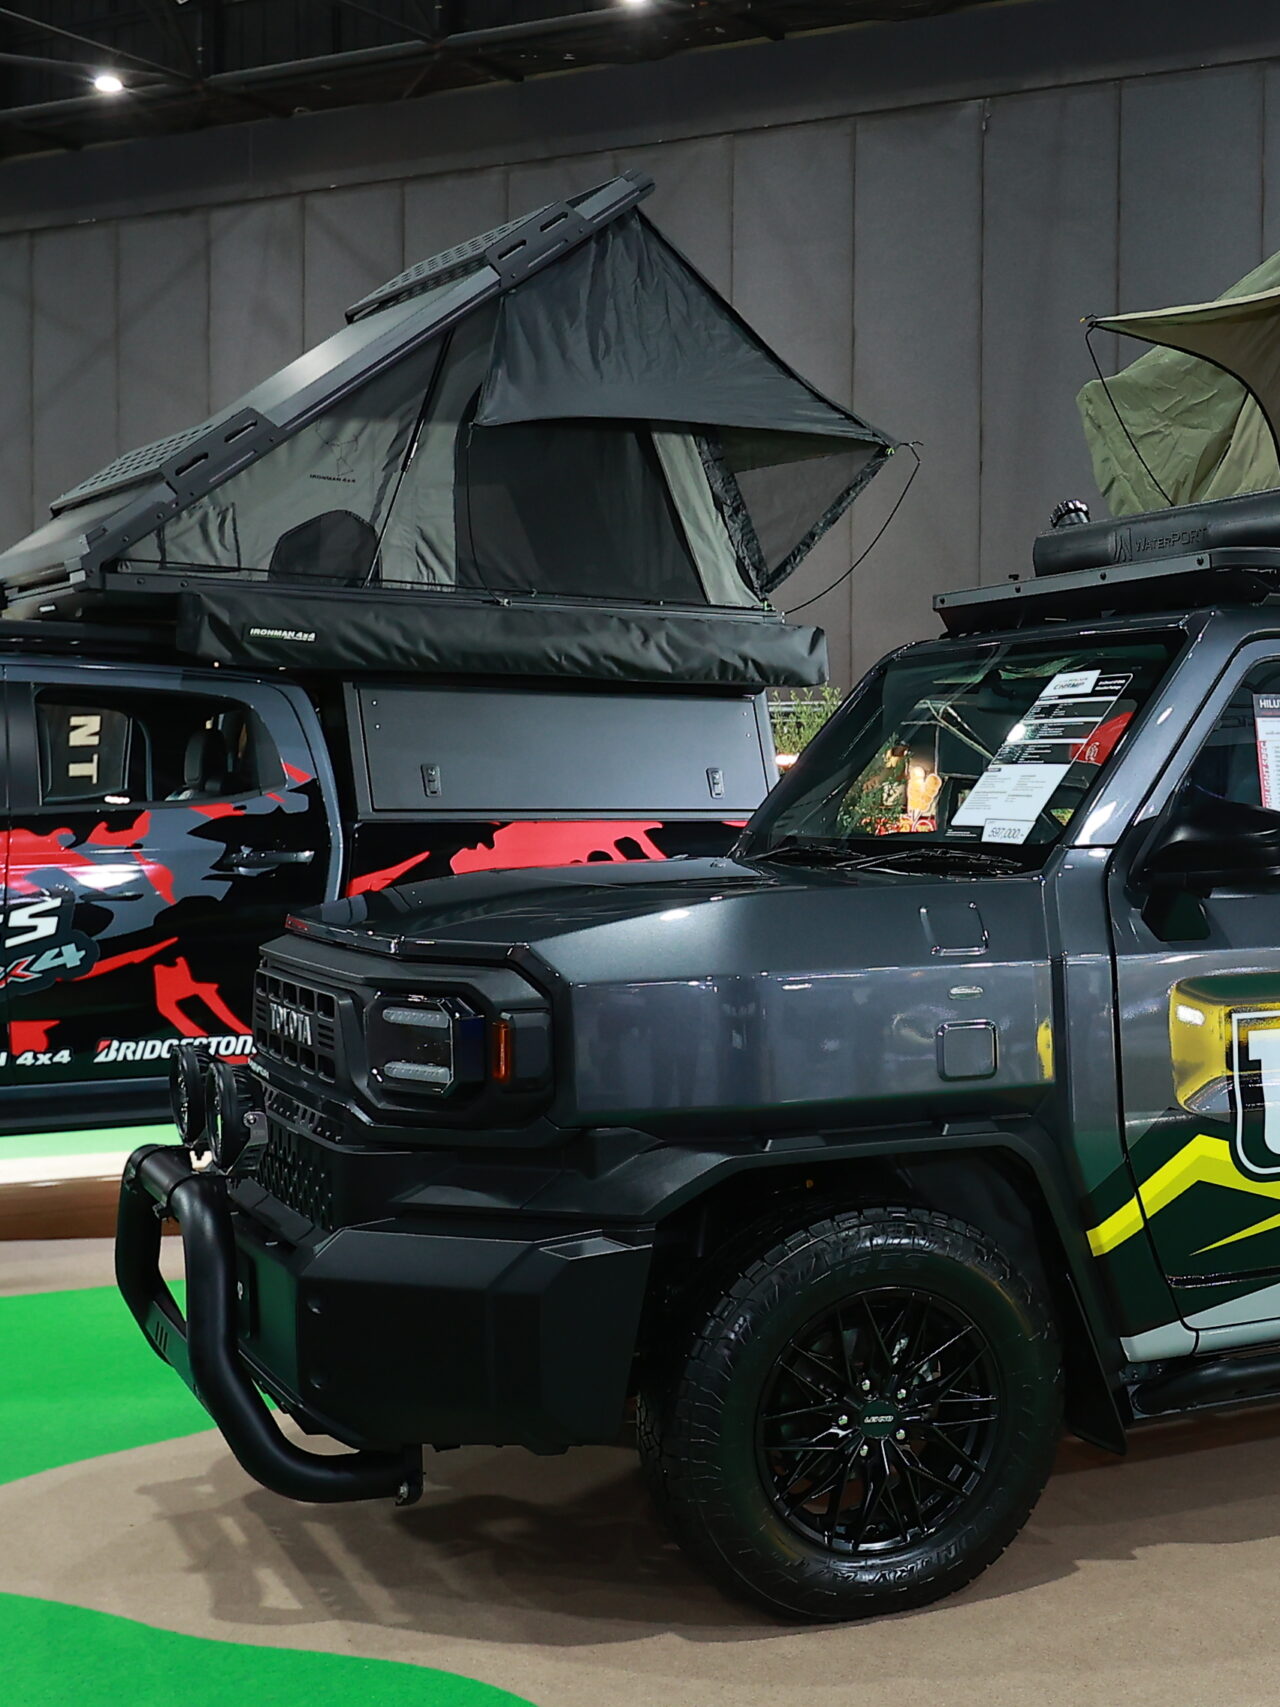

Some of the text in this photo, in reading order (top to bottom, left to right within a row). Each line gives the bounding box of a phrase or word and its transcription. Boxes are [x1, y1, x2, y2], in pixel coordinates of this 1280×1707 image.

[250, 627, 295, 638] IRONMAN
[0, 897, 62, 949] S
[270, 1002, 312, 1046] TOYOTA
[16, 1050, 71, 1066] 4x4
